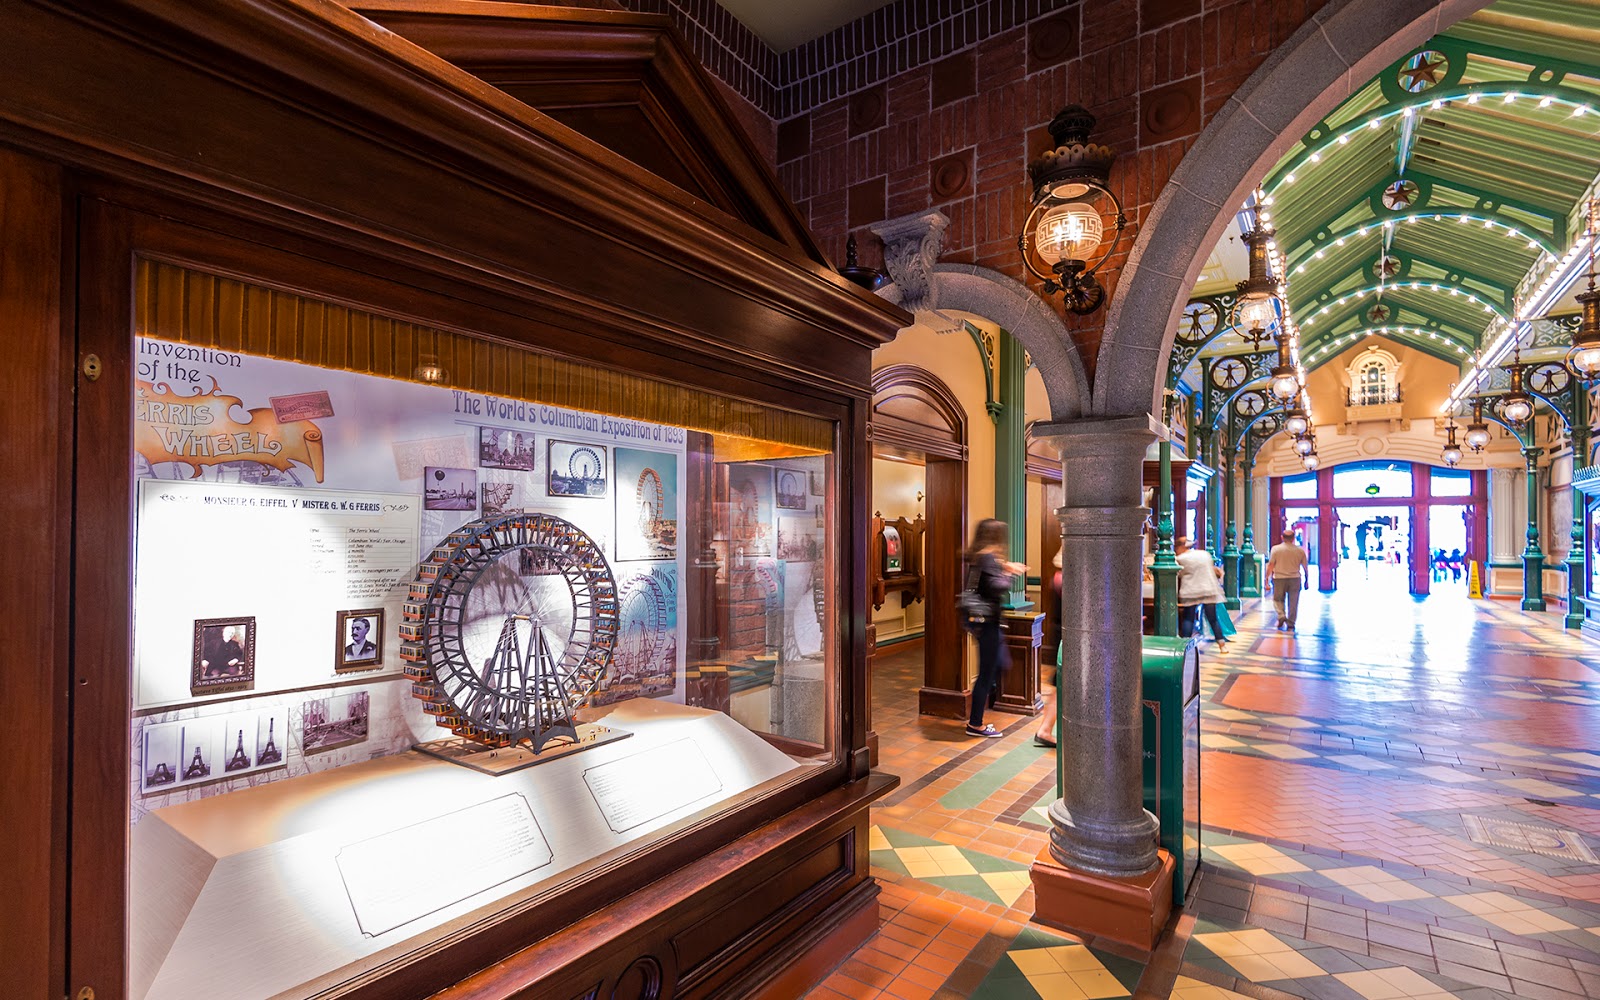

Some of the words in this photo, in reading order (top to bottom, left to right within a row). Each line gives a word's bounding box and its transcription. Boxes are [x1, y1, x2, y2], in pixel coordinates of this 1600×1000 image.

[140, 338, 241, 367] Invention
[138, 360, 160, 381] of
[166, 362, 201, 383] the
[137, 390, 215, 426] ERRIS
[452, 390, 481, 415] The
[485, 395, 536, 423] World's
[540, 405, 599, 432] Columbian
[601, 415, 651, 440] Exposition
[653, 425, 662, 441] of
[664, 426, 684, 444] 1893
[151, 426, 283, 457] WHEEL
[260, 498, 288, 508] EIFFEL
[302, 500, 330, 510] MISTER
[356, 502, 380, 512] FERRIS
